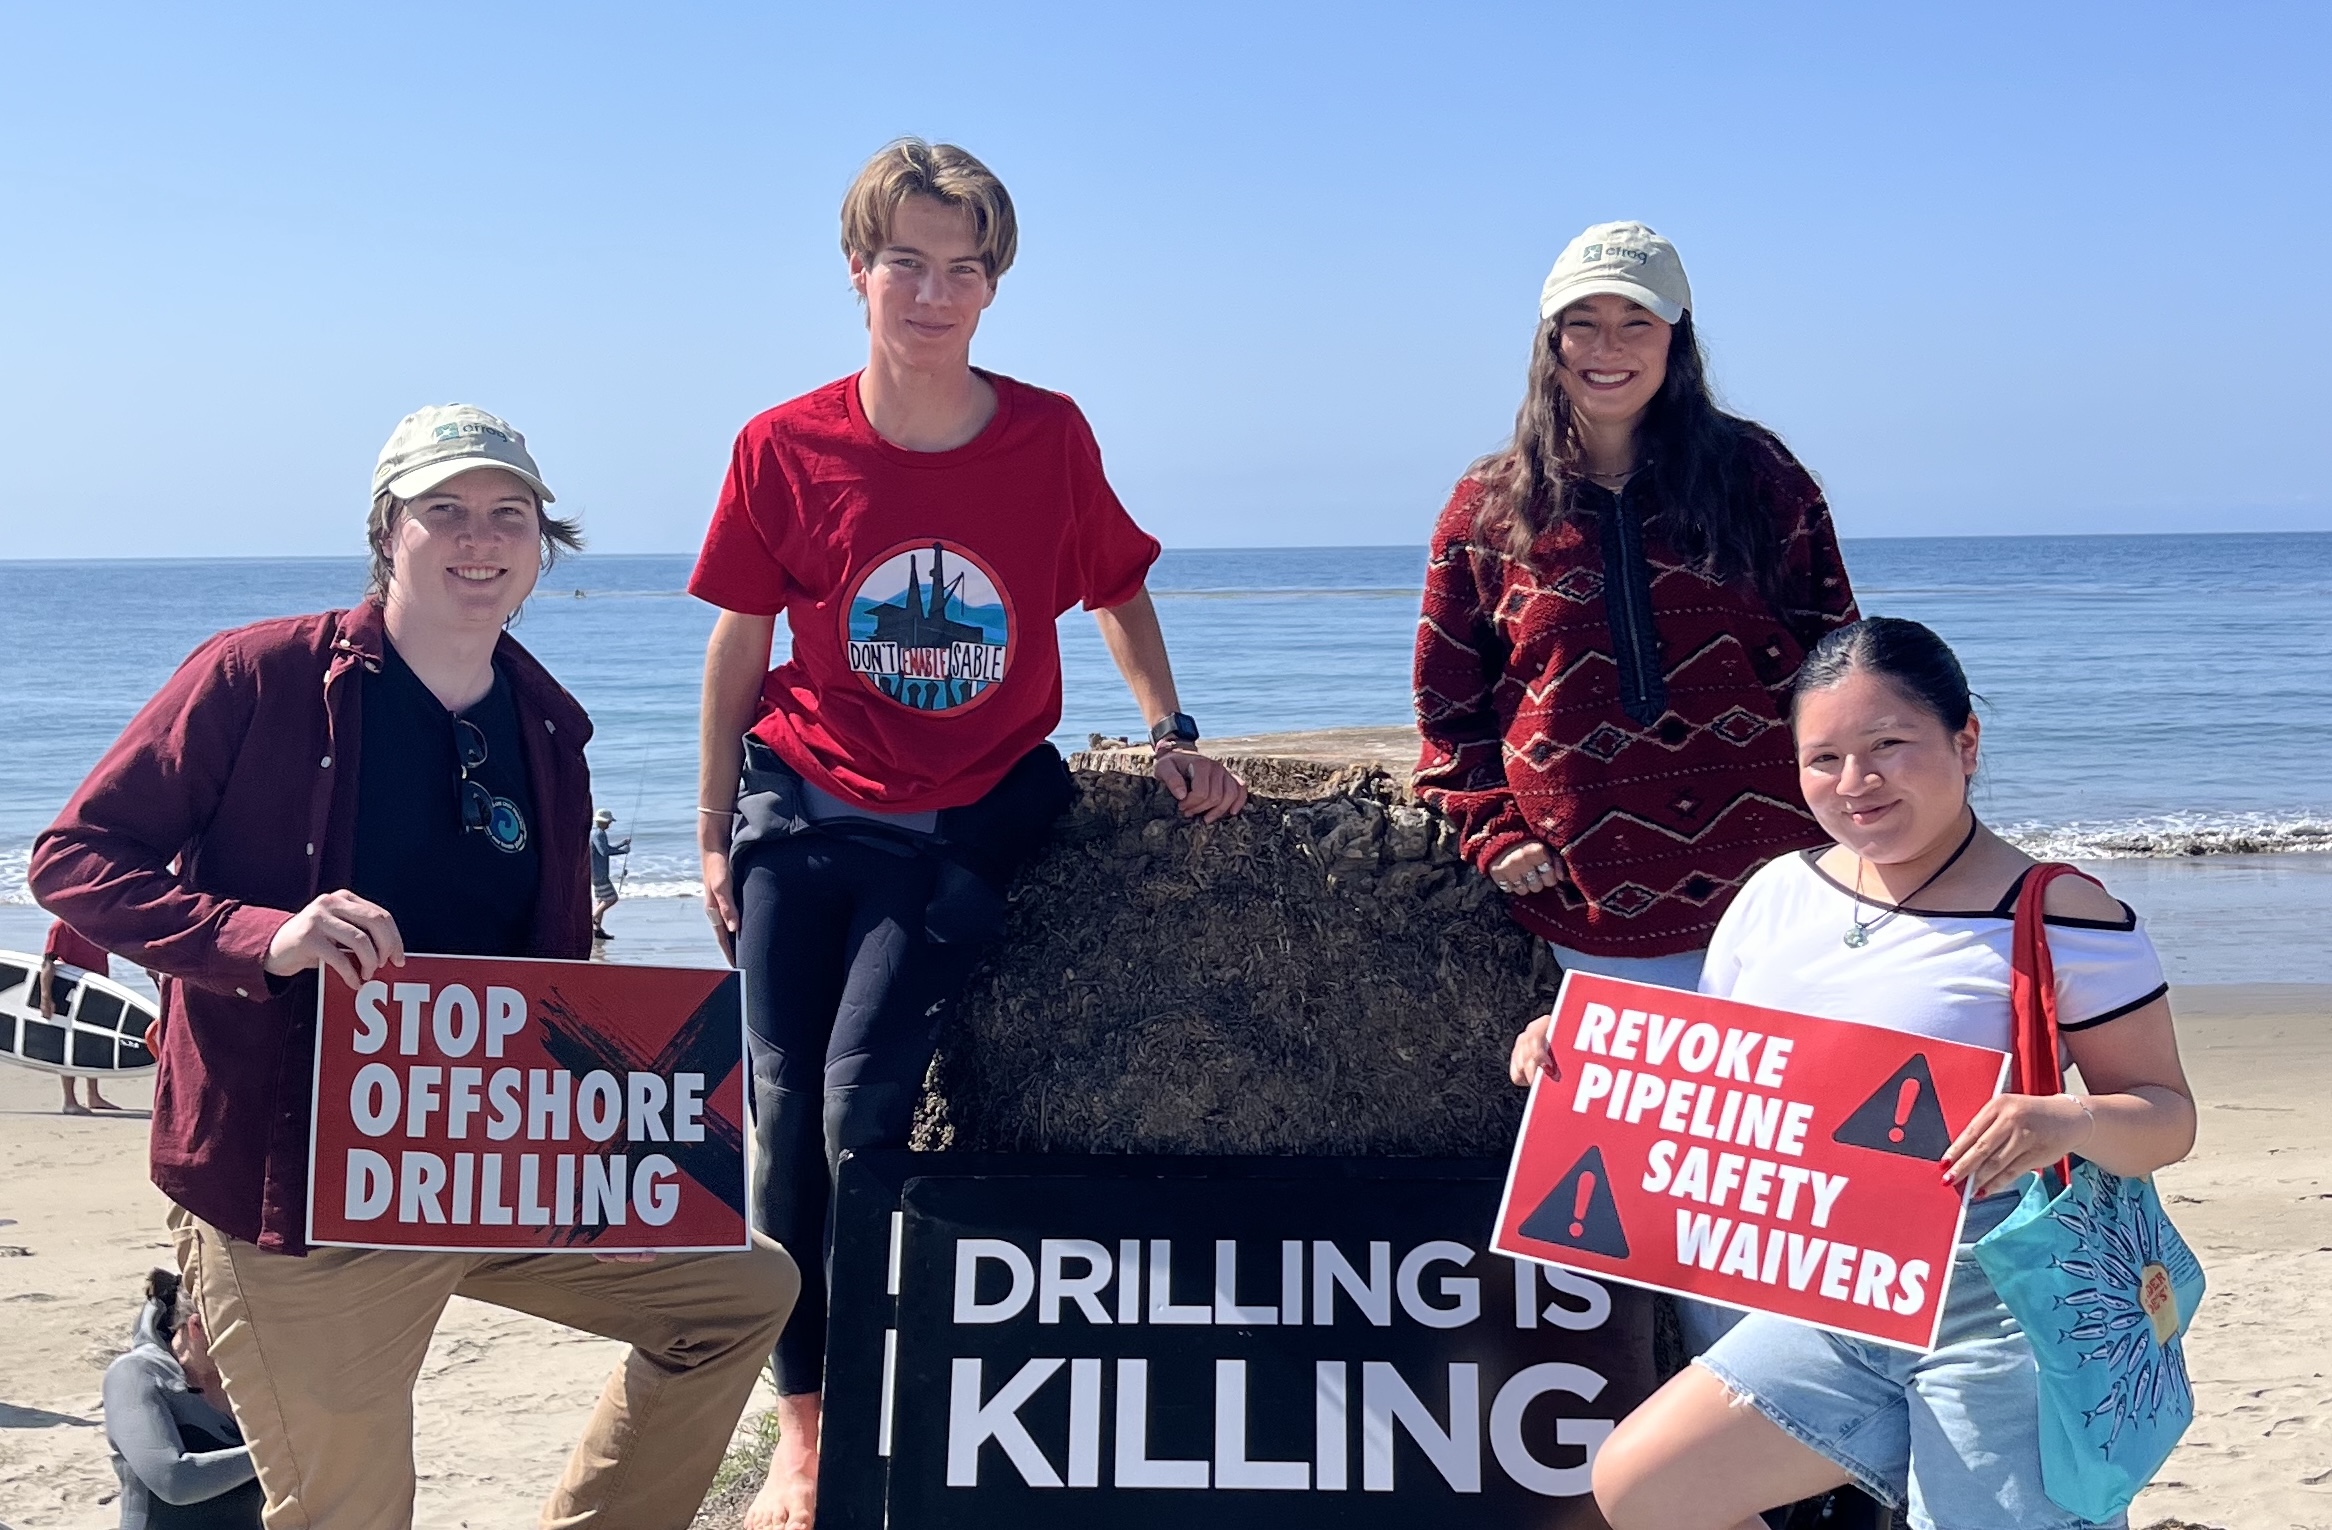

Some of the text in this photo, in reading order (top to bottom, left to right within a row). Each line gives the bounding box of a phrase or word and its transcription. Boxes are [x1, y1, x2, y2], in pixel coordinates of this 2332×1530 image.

[850, 643, 1002, 681] DON'T ENABLE SABLE
[353, 980, 528, 1058] STOP
[1573, 1001, 1795, 1089] REVOKE
[350, 1063, 705, 1142] OFFSHORE
[1572, 1062, 1815, 1157] PIPELINE
[344, 1148, 680, 1227] DRILLING
[1641, 1139, 1850, 1229] SAFETY
[953, 1238, 1612, 1331] DRILLING IS
[1676, 1208, 1931, 1316] WAIVERS
[946, 1357, 1615, 1497] KILLING
